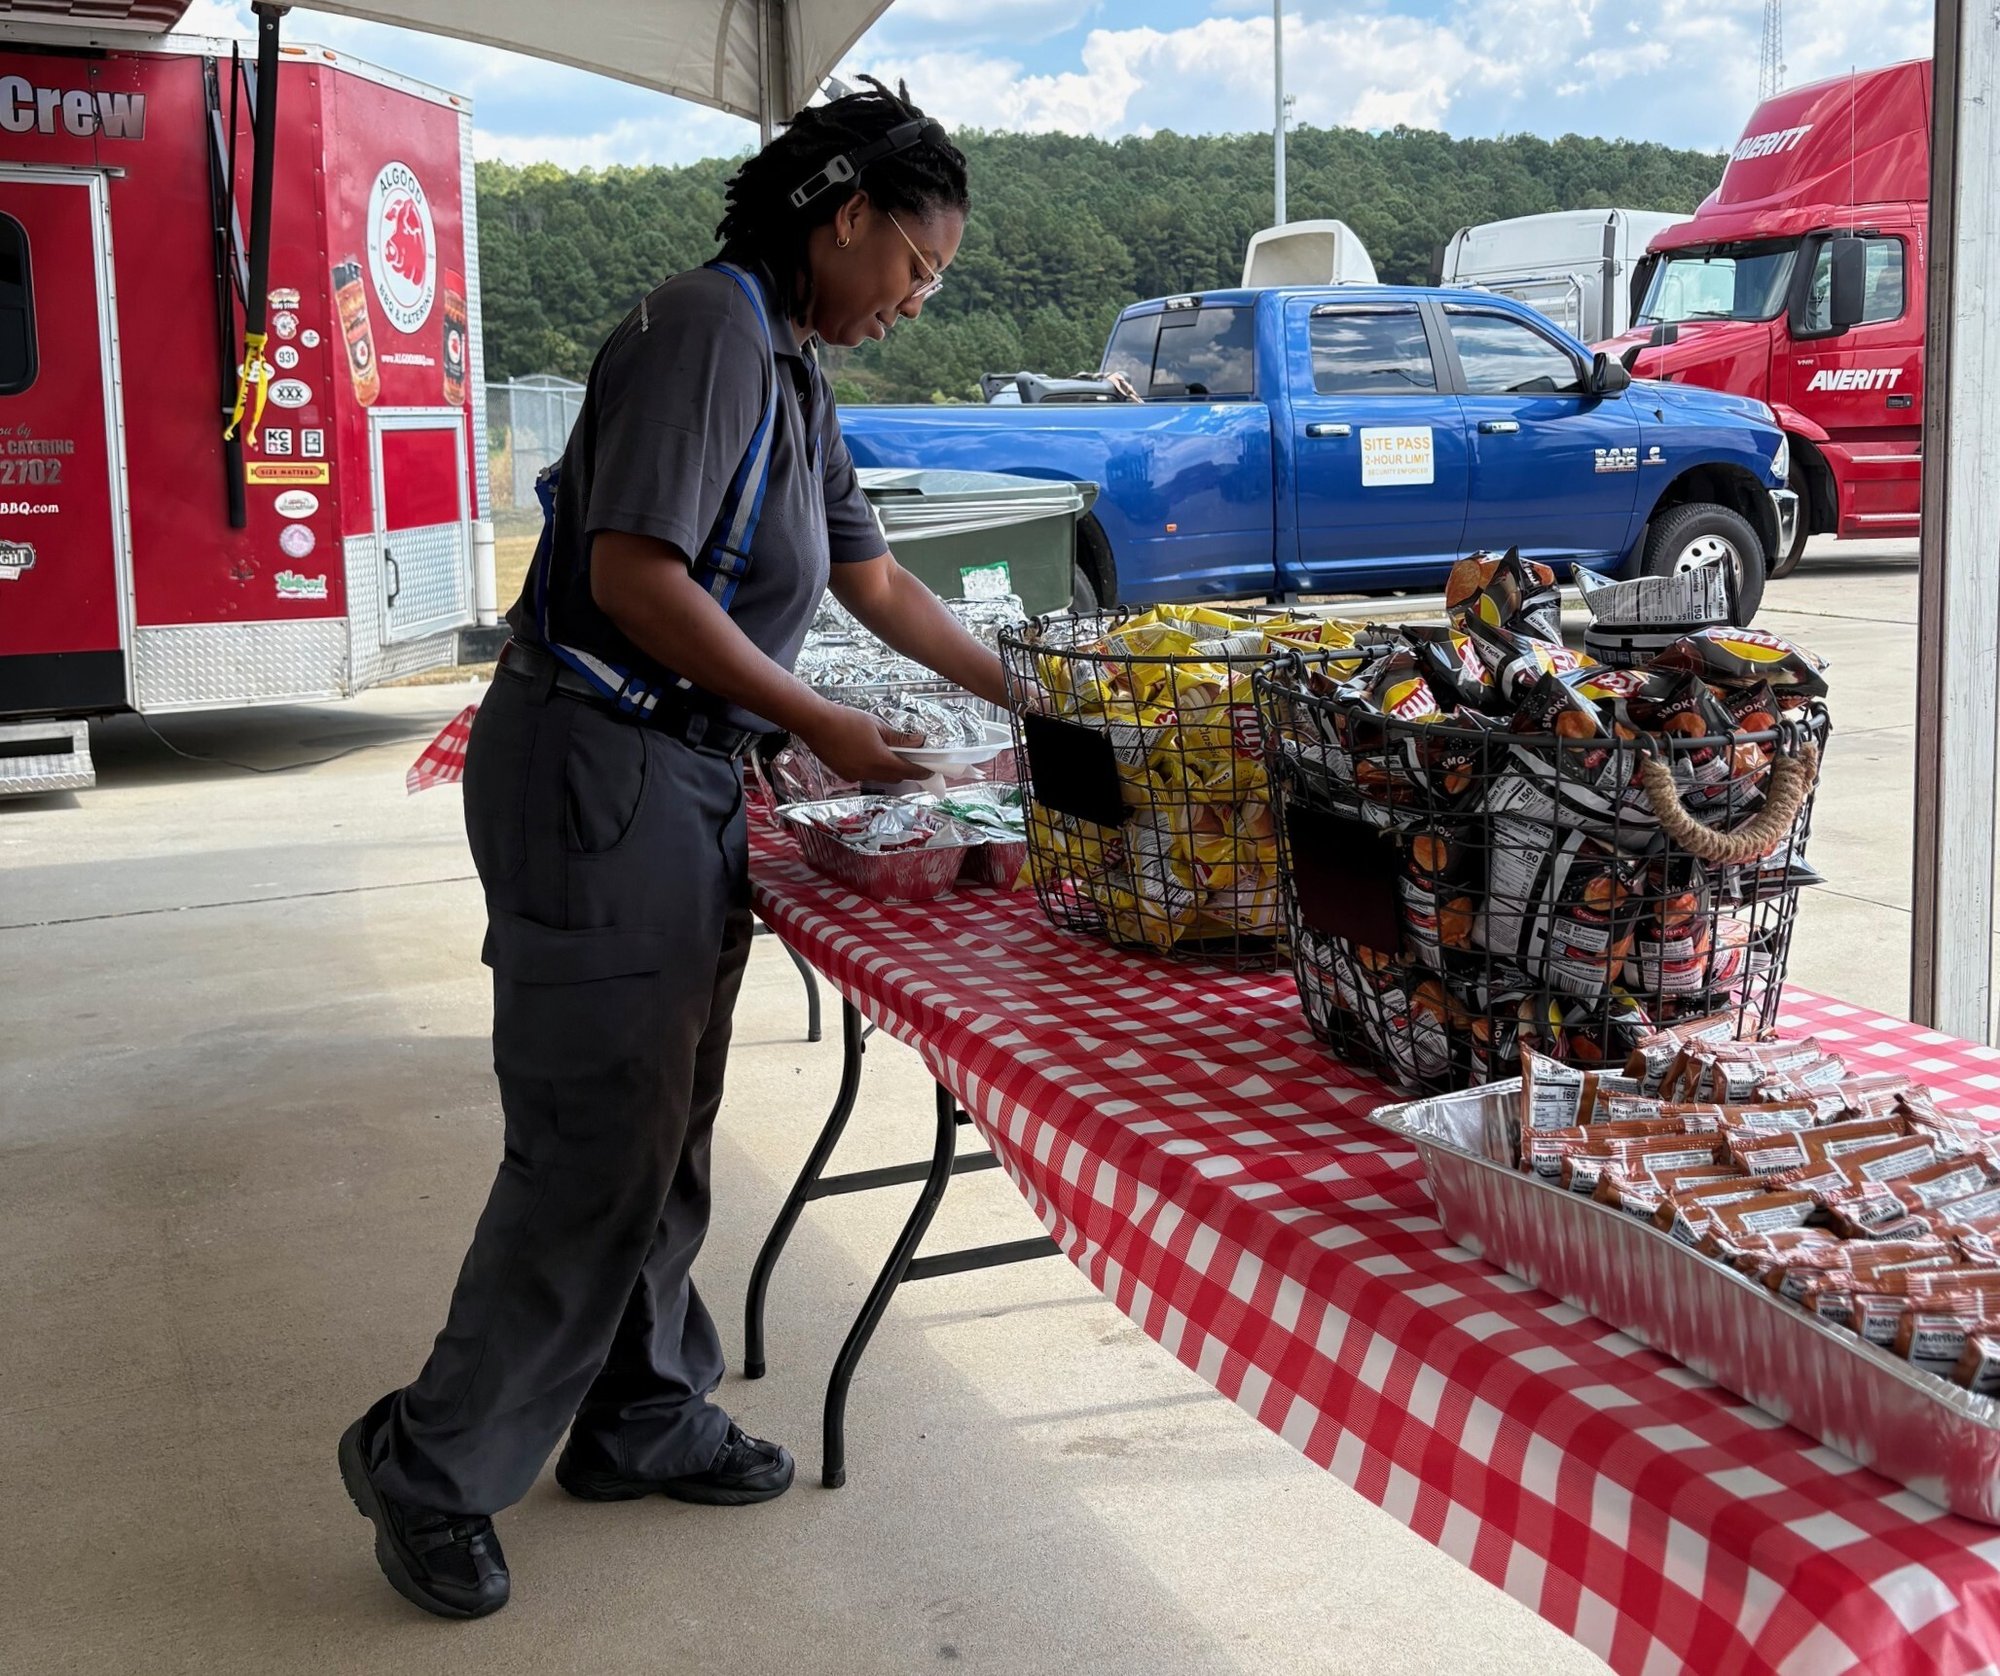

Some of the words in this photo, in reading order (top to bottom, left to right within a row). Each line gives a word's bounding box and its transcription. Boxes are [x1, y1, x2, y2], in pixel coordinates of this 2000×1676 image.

[0, 75, 146, 139] Crew
[1733, 124, 1815, 161] AVERITT
[380, 168, 422, 205] ALGOOD
[278, 351, 295, 363] 931
[1806, 368, 1904, 392] AVERITT
[277, 386, 303, 399] XXX
[1364, 437, 1393, 451] SITE
[1396, 436, 1431, 450] PASS
[1595, 447, 1638, 458] RAM
[1365, 454, 1403, 466] 2-HOUR
[1405, 453, 1431, 465] LIMIT
[0, 459, 62, 486] 2702
[1542, 695, 1569, 729] SMOKY
[1656, 696, 1698, 719] SMOKY
[1517, 786, 1535, 804] 150
[1528, 822, 1552, 840] Facts
[1521, 850, 1540, 864] 150
